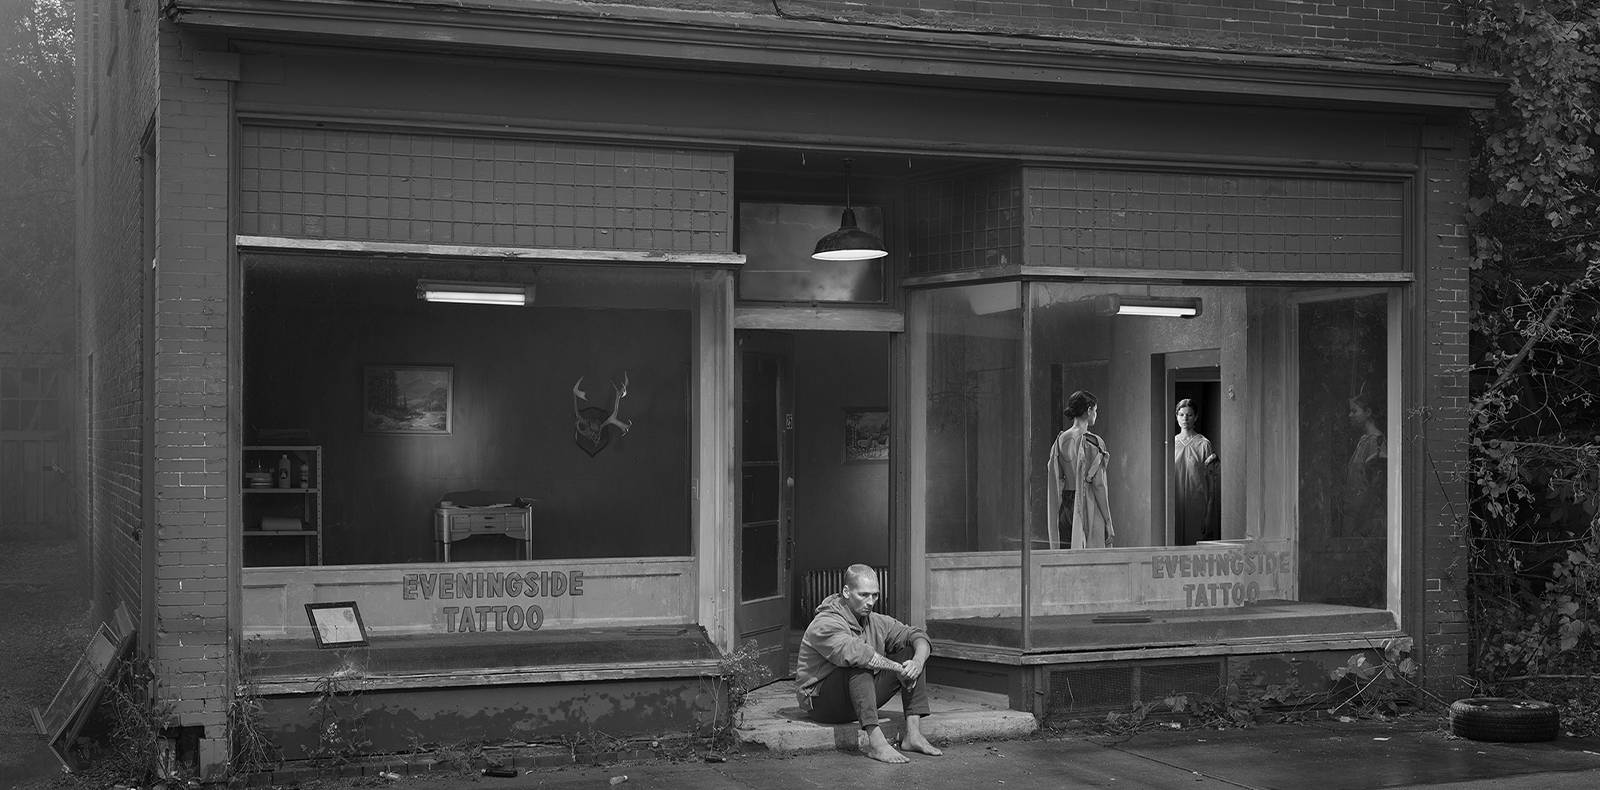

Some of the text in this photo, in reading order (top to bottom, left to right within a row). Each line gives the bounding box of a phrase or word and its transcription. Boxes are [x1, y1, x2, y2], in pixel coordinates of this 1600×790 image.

[1152, 552, 1290, 578] EVENINGSIDE
[403, 571, 583, 600] EVENINGSIDE
[1183, 582, 1258, 607] TATTOO
[443, 605, 544, 632] TATTOO
